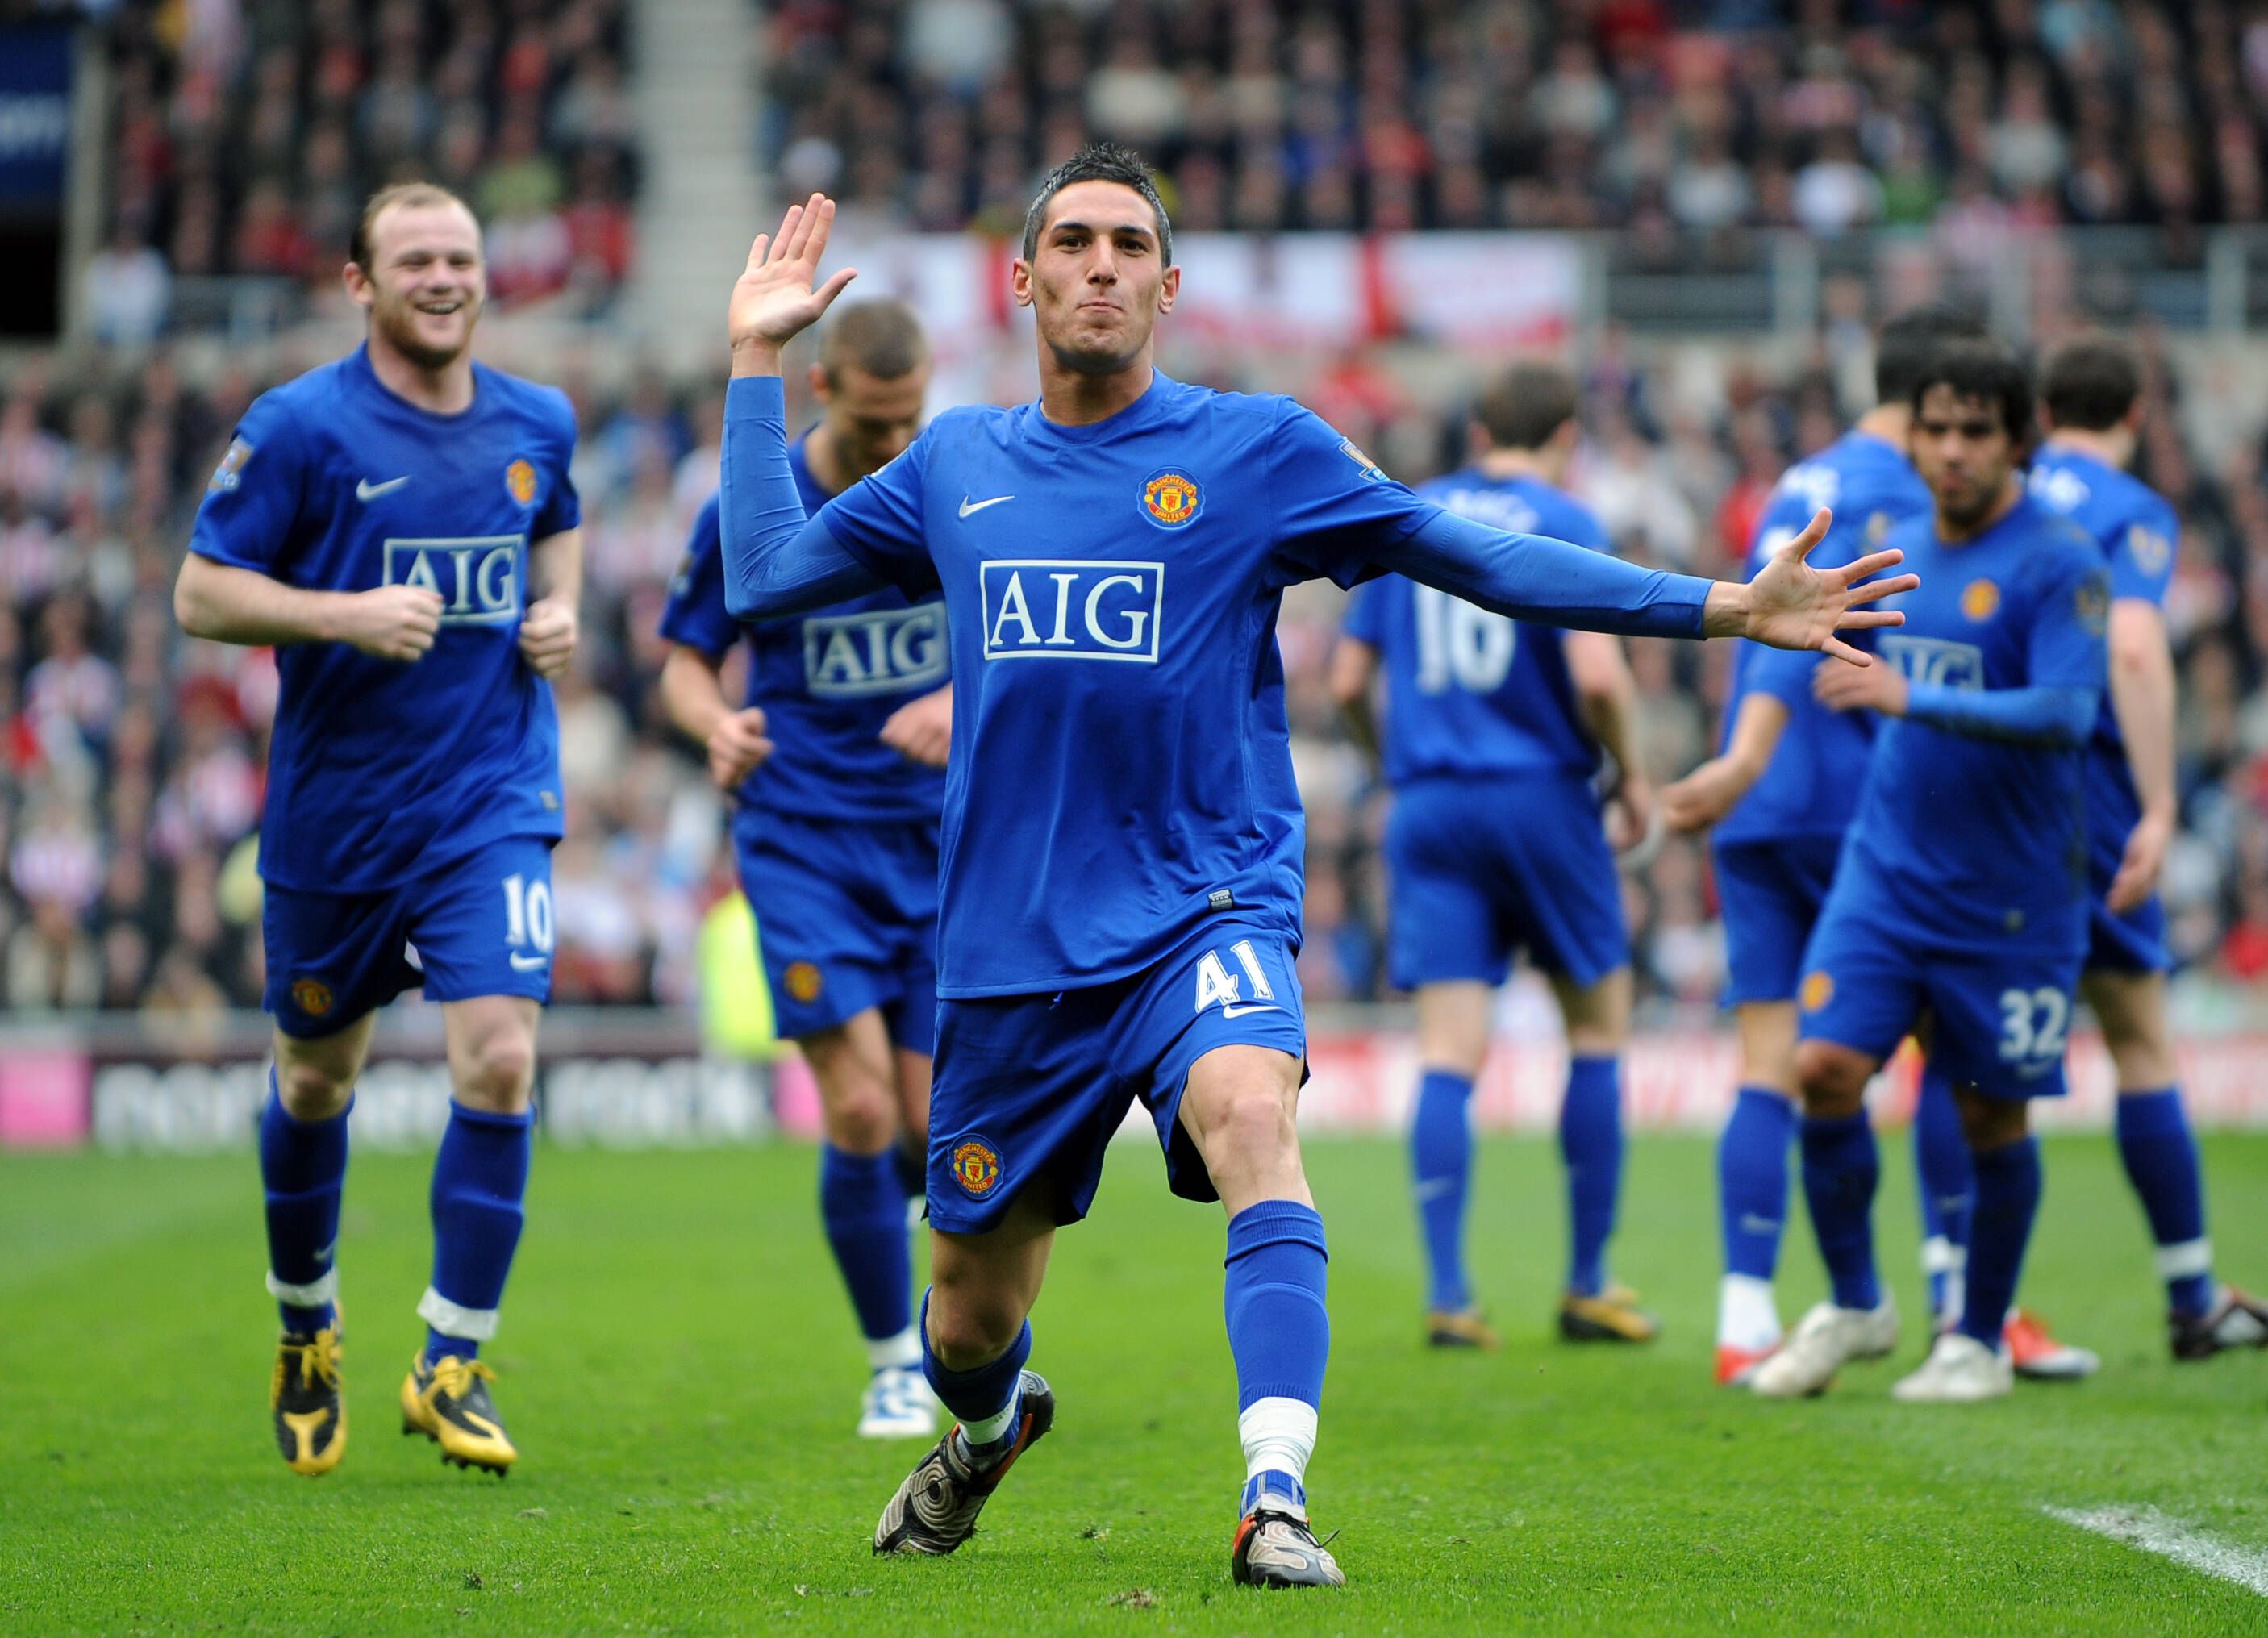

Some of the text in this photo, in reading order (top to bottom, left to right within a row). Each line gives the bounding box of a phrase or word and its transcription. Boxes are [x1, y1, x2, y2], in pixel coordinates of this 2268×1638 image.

[1155, 510, 1186, 519] UNITED
[405, 545, 516, 613] AIG
[990, 570, 1149, 648] AIG
[817, 615, 940, 681] AIG
[502, 873, 553, 952] 10
[1194, 940, 1275, 1014] 41
[1999, 986, 2067, 1061] 32
[963, 1179, 987, 1190] UNITED
